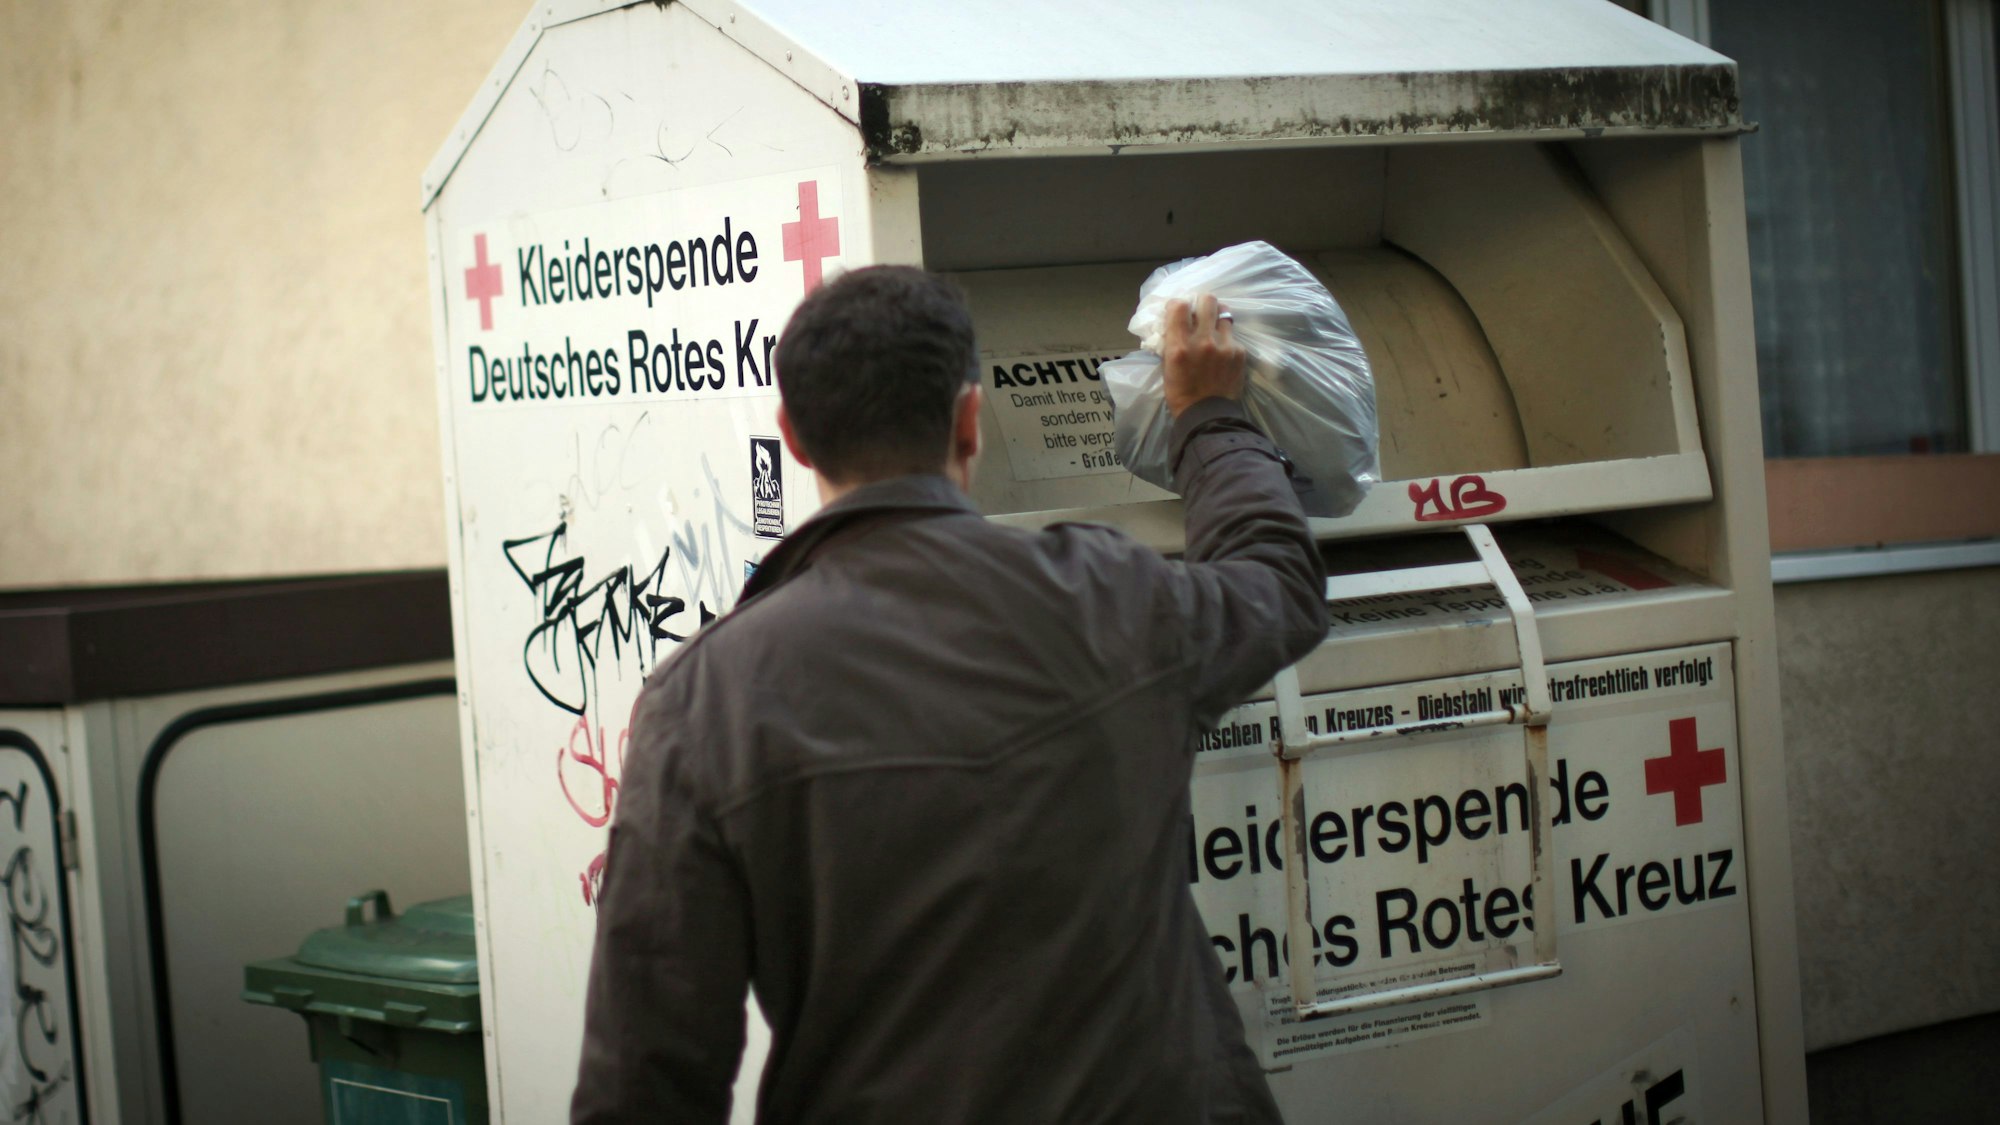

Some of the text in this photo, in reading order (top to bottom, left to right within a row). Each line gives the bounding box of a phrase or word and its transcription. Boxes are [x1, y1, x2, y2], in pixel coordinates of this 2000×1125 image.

[518, 216, 758, 308] Kleiderspende
[468, 318, 777, 403] Deutsches Rotes Kr
[992, 355, 1122, 389] ACHTU
[1010, 391, 1055, 408] Damit
[1056, 389, 1087, 405] Ihre
[1040, 410, 1101, 427] sondern
[1043, 433, 1078, 449] bitte
[1334, 605, 1427, 625] Keine
[1325, 703, 1395, 733] Kreuzes
[1418, 685, 1493, 721] Diebstahl
[1498, 682, 1528, 708] wir
[1547, 665, 1649, 702] trafrechtlich
[1654, 656, 1713, 687] verfolgt
[1571, 849, 1737, 924] Kreuz
[1438, 963, 1476, 975] Betreuung
[1272, 1040, 1334, 1058] gemeinnützigen
[1335, 1032, 1371, 1045] Aufgaben
[1372, 1030, 1386, 1039] des
[1441, 1011, 1483, 1026] verwendet.
[1277, 1003, 1477, 1046] Die Erlöse werden für die Finanzierung der vielfältigen
